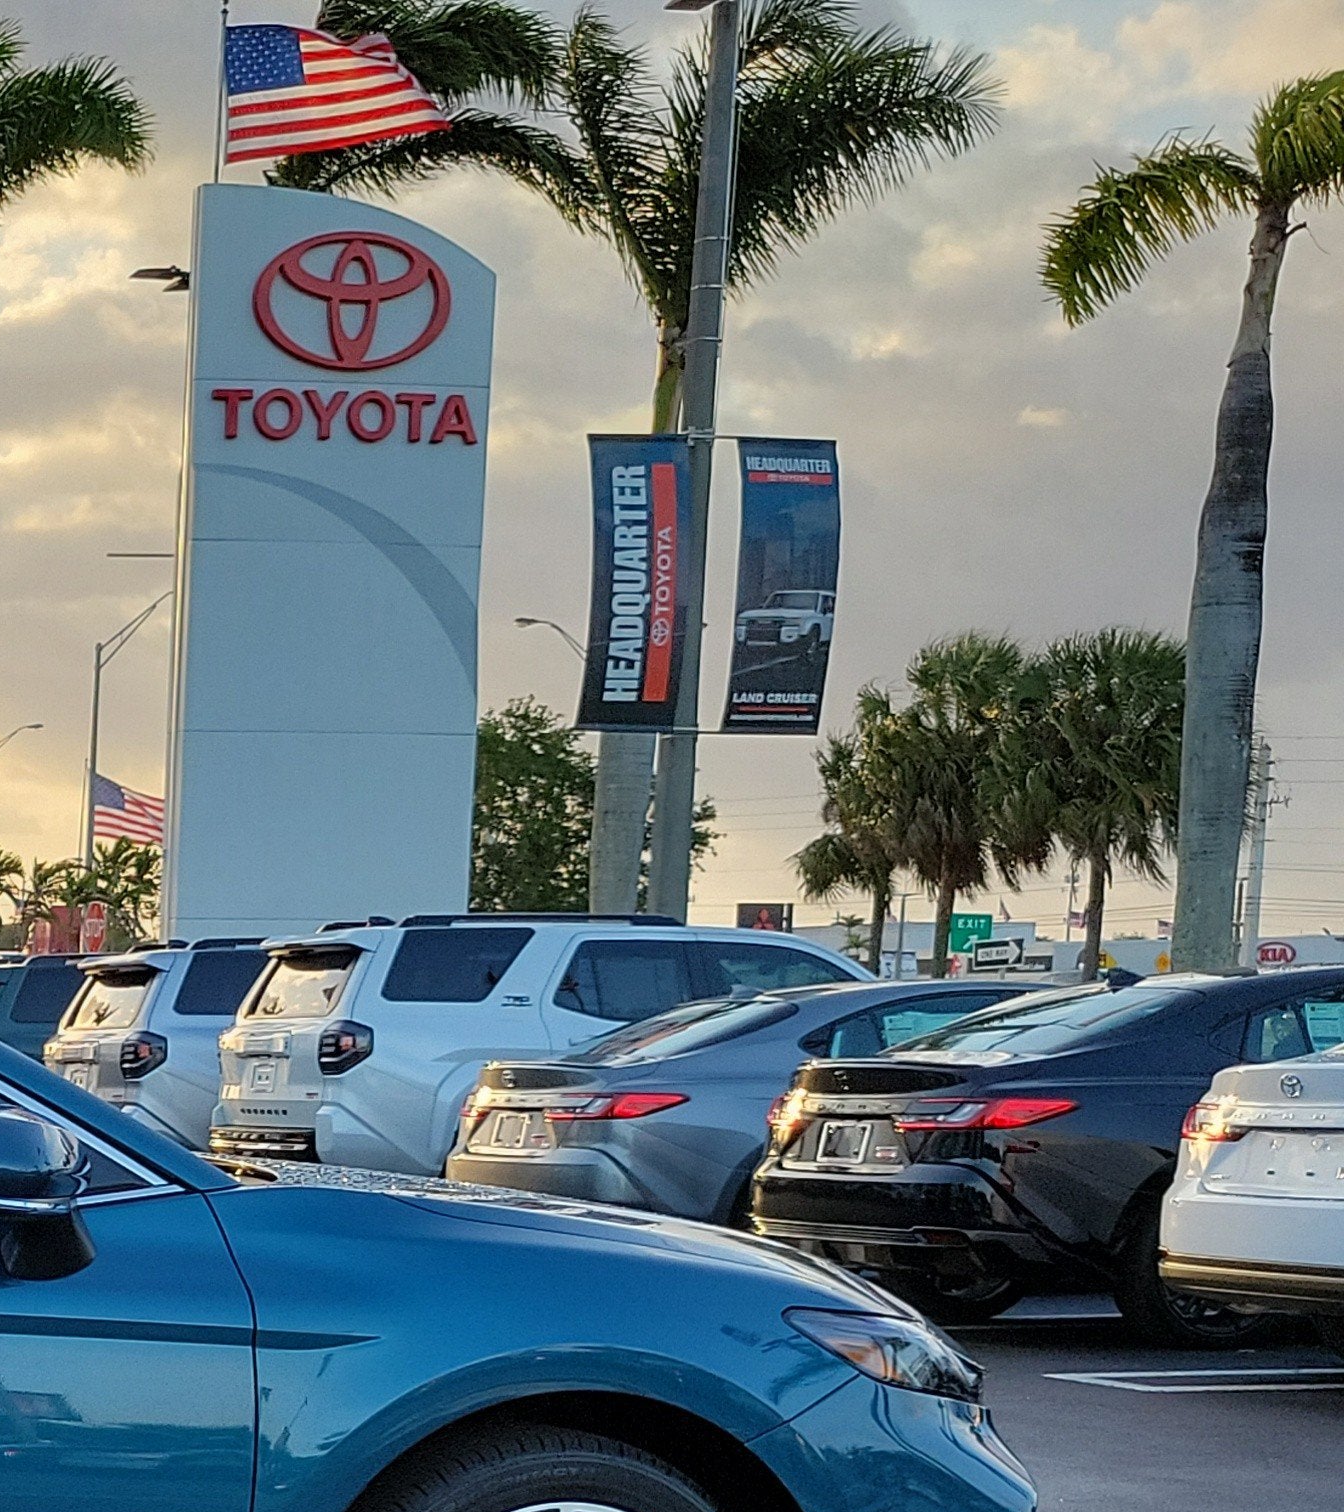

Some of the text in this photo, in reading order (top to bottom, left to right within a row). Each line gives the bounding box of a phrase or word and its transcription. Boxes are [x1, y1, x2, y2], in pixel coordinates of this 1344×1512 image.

[212, 388, 478, 445] TOYOTA
[745, 456, 831, 473] HEADQUARTER
[654, 526, 673, 614] TOYOTA
[602, 465, 651, 702] HEADQUARTER
[732, 692, 818, 704] LAND CRUISER
[957, 918, 987, 929] EXIT
[1261, 947, 1289, 963] KIA
